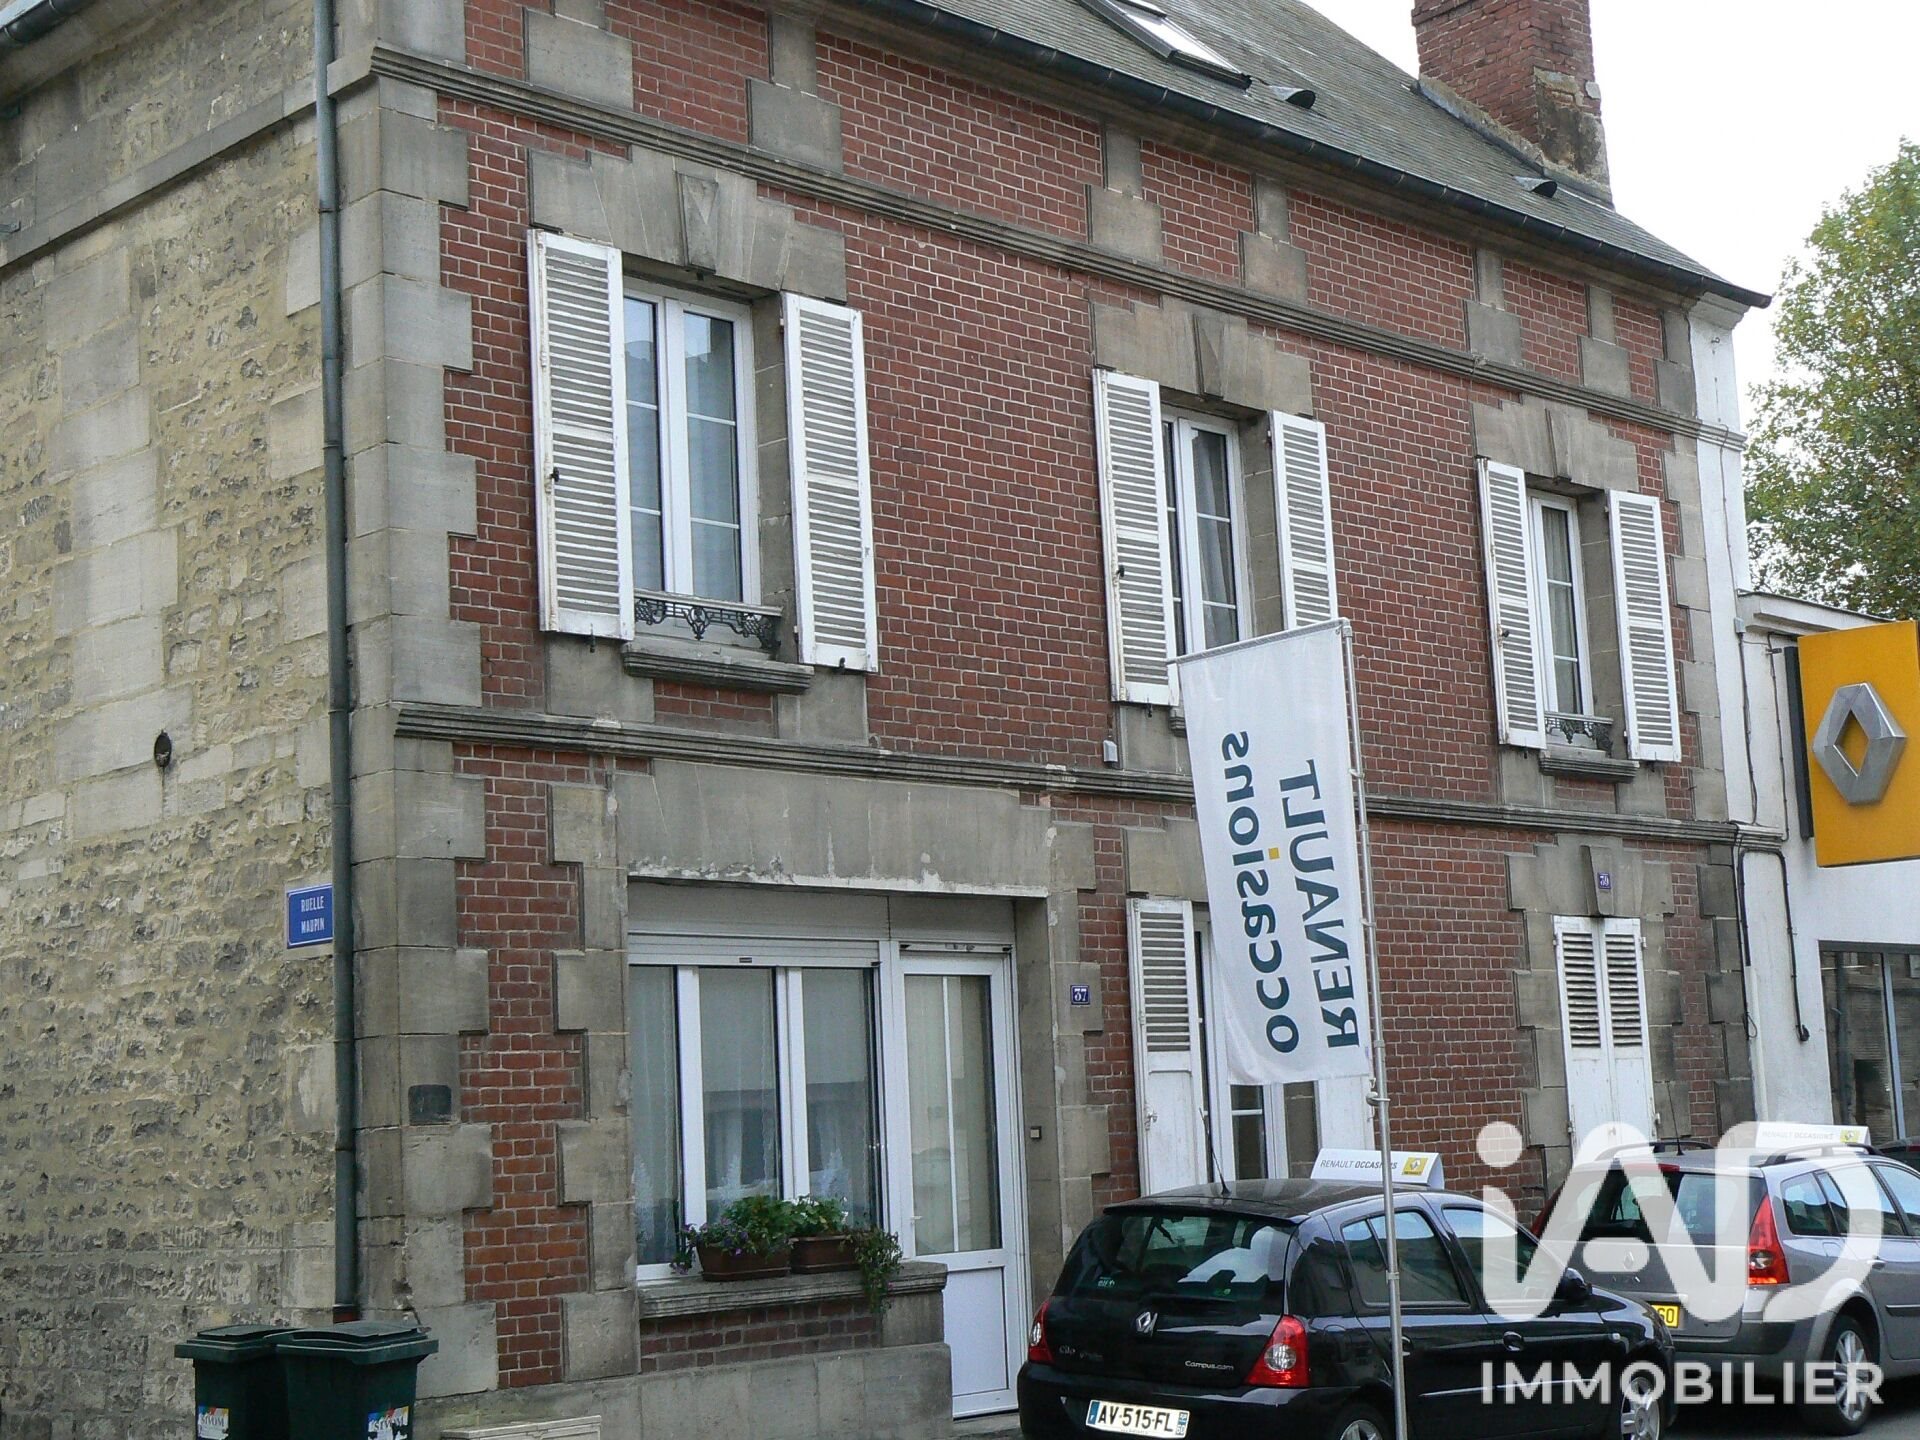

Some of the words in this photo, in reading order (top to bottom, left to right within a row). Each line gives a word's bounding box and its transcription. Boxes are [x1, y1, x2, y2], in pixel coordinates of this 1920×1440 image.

[301, 895, 325, 913] RUELLE
[1074, 988, 1087, 1002] 37
[1320, 1159, 1354, 1169] RENAULT
